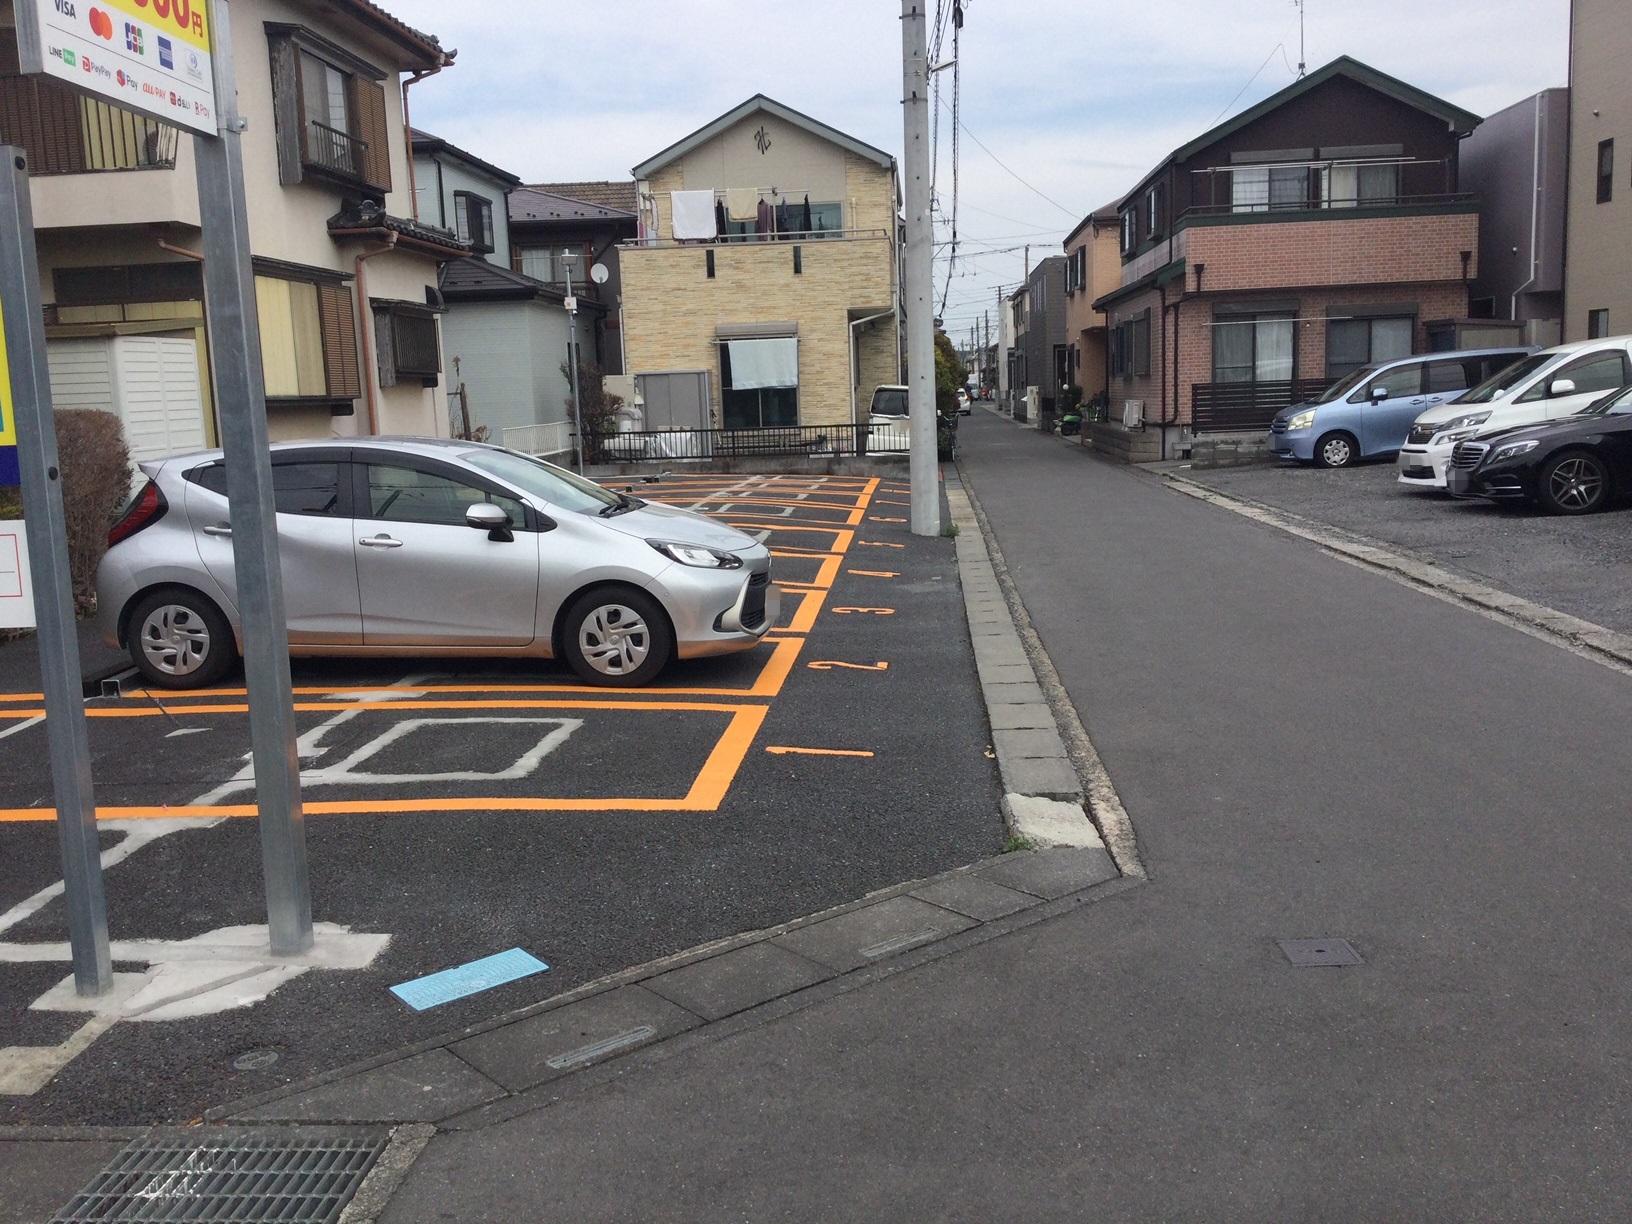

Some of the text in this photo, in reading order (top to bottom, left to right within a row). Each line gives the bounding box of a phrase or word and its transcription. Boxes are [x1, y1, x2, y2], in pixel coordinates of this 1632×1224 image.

[54, 0, 77, 19] VISA
[134, 0, 204, 38] 00円
[48, 46, 63, 59] LINE
[91, 62, 111, 79] PayPay
[126, 74, 138, 91] Pay
[807, 661, 889, 670] 2
